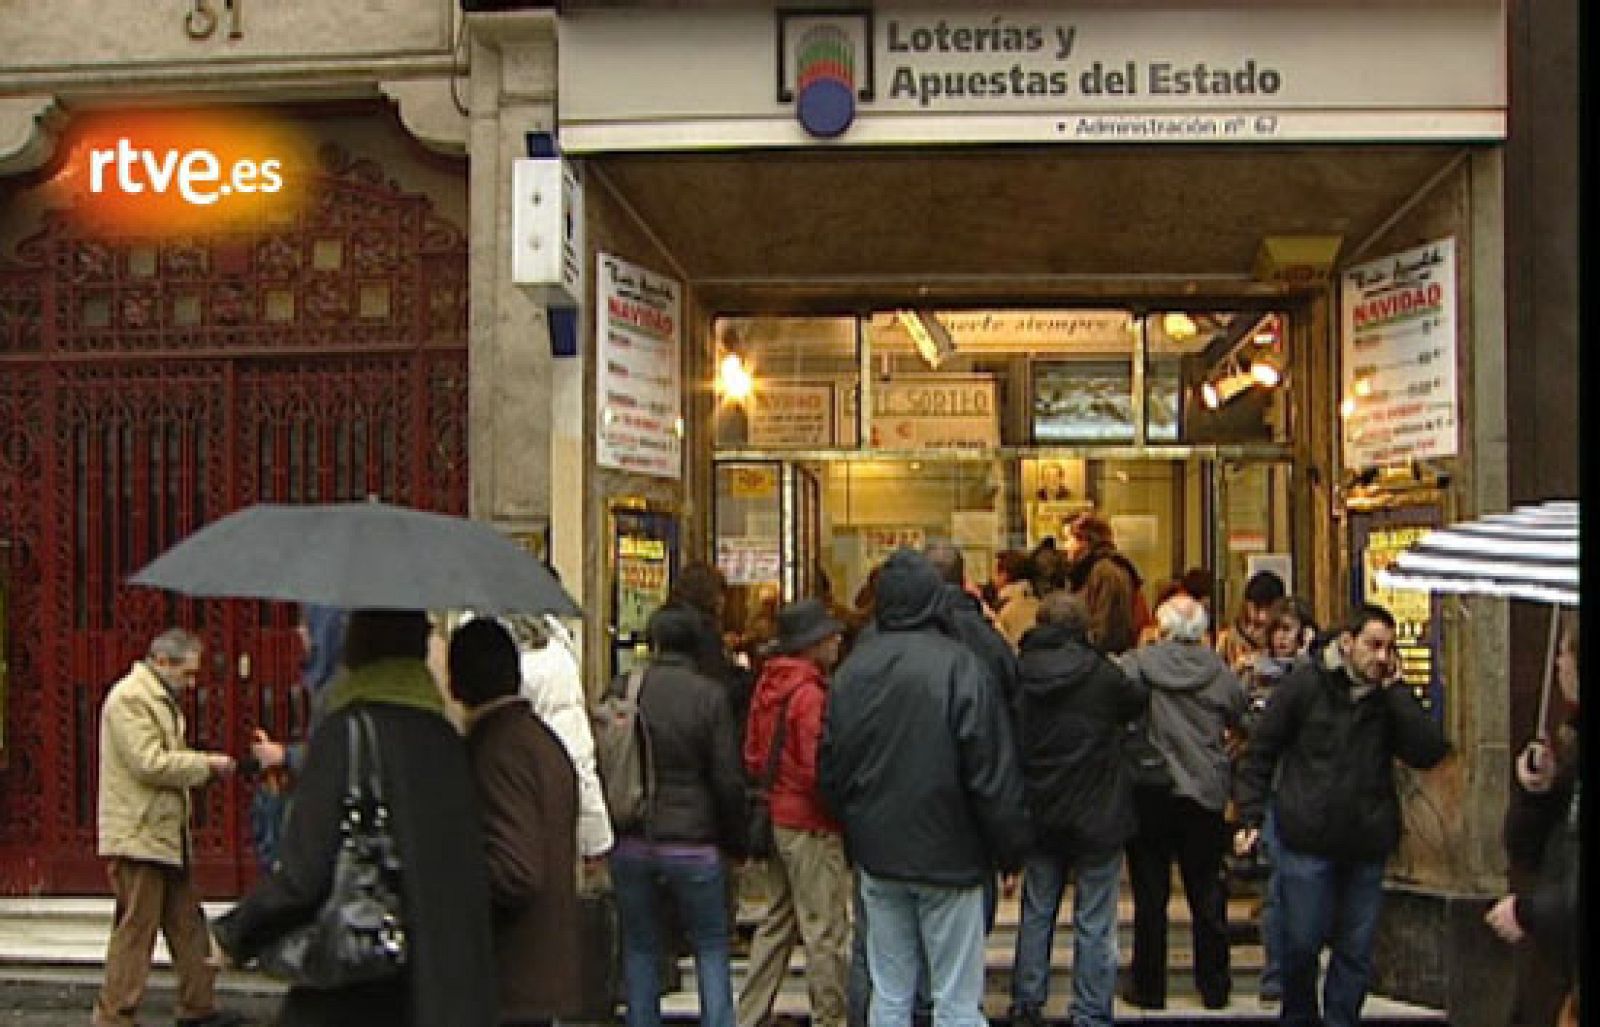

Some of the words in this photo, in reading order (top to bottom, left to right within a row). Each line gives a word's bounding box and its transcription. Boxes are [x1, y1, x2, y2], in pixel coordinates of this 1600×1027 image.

[887, 17, 1044, 53] Loterías
[1055, 24, 1077, 59] y
[890, 64, 1069, 104] Apuestas
[1079, 61, 1136, 94] del
[1148, 60, 1282, 95] Estado
[607, 294, 674, 337] NAVIDAD
[1353, 281, 1443, 326] NAVIDAD
